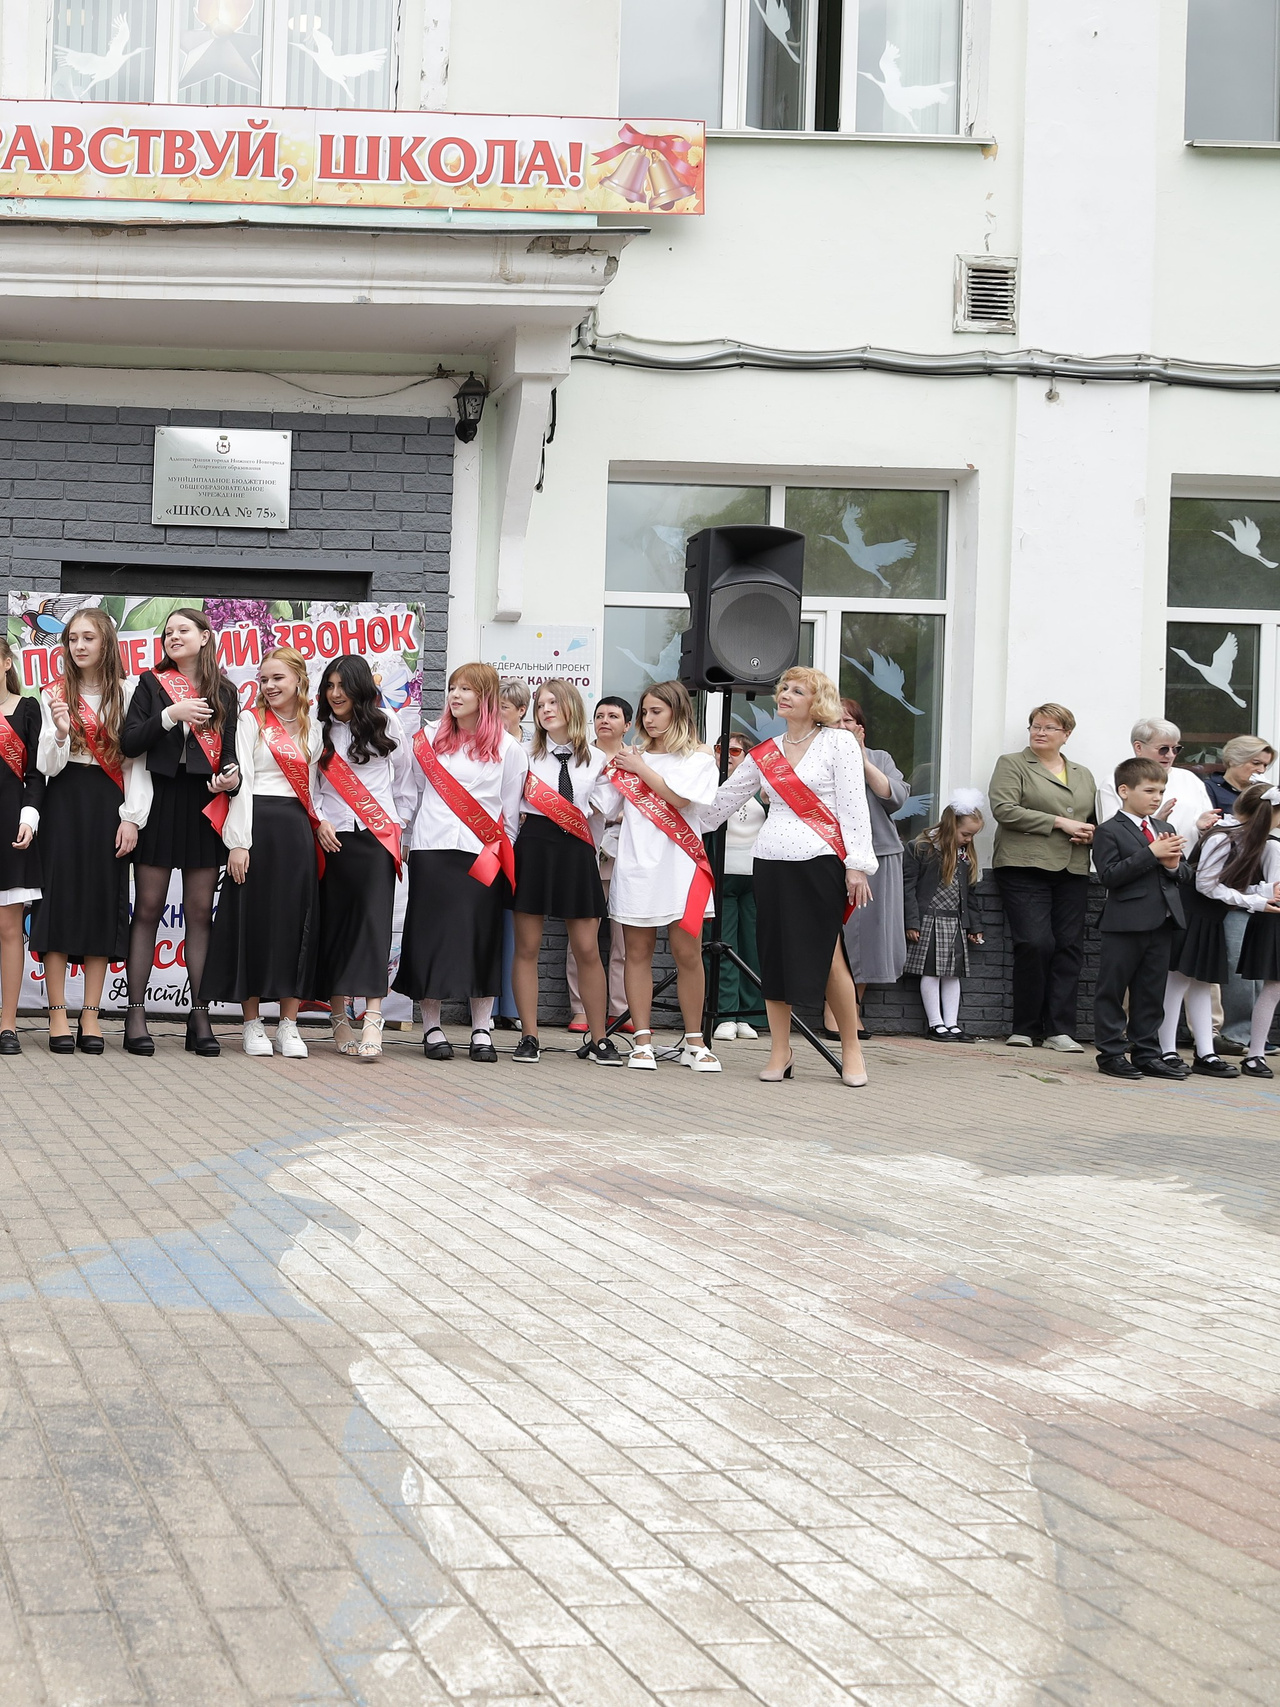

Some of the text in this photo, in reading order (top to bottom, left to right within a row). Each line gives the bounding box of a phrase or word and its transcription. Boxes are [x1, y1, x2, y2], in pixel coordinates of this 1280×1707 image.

[318, 133, 583, 188] ШКОЛА!
[167, 476, 277, 486] МУНИЦИПАЛЬНОЕ БЮДЖЕТНОЕ
[179, 484, 265, 492] ОБЩЕОБРАЗОВАТЕЛЬНОЕ
[198, 491, 245, 499] УЧРЕЖДЕНИЕ
[165, 504, 277, 519] «ШКОЛА № 75»
[273, 613, 417, 661] ЗВОНОК
[556, 663, 591, 672] ПРОЕКТ
[422, 751, 469, 813] Выпускница
[465, 808, 502, 843] 2025
[355, 795, 391, 831] 2025
[618, 771, 677, 829] Выпускница
[674, 826, 707, 861] 2025
